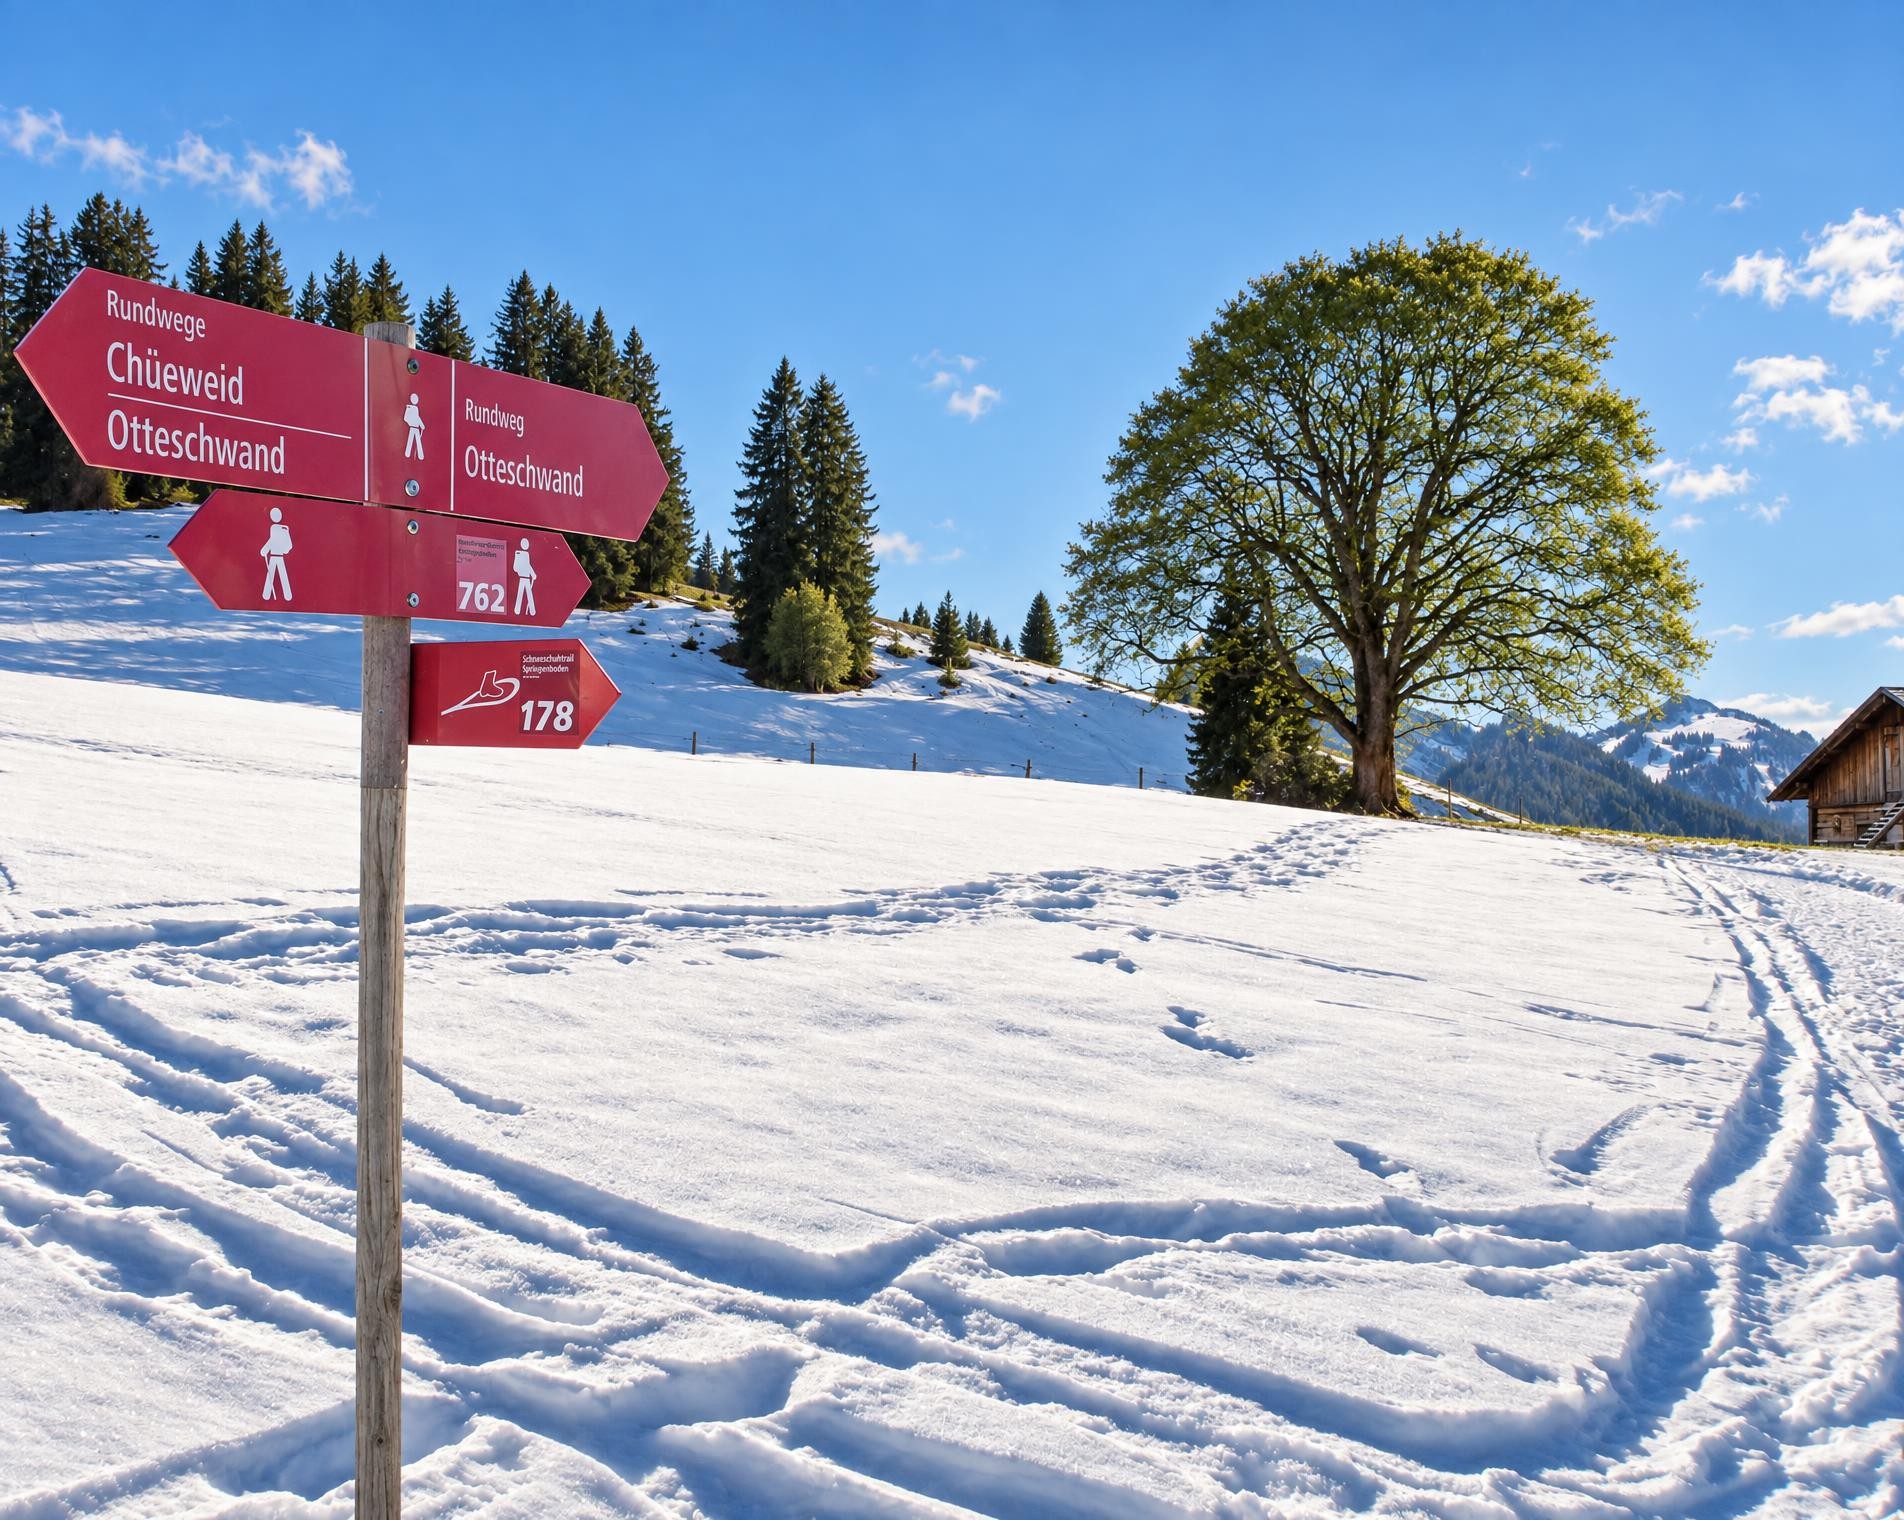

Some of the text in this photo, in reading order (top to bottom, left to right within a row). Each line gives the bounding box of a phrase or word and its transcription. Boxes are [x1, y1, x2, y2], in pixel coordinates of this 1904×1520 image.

[107, 289, 206, 342] Rundwege
[107, 342, 243, 406] Chüeweid
[107, 409, 285, 475] Otteschwand
[466, 398, 524, 437] Rundweg
[465, 445, 583, 497] Otteschwand
[458, 581, 505, 613] 762
[521, 700, 574, 732] 178
